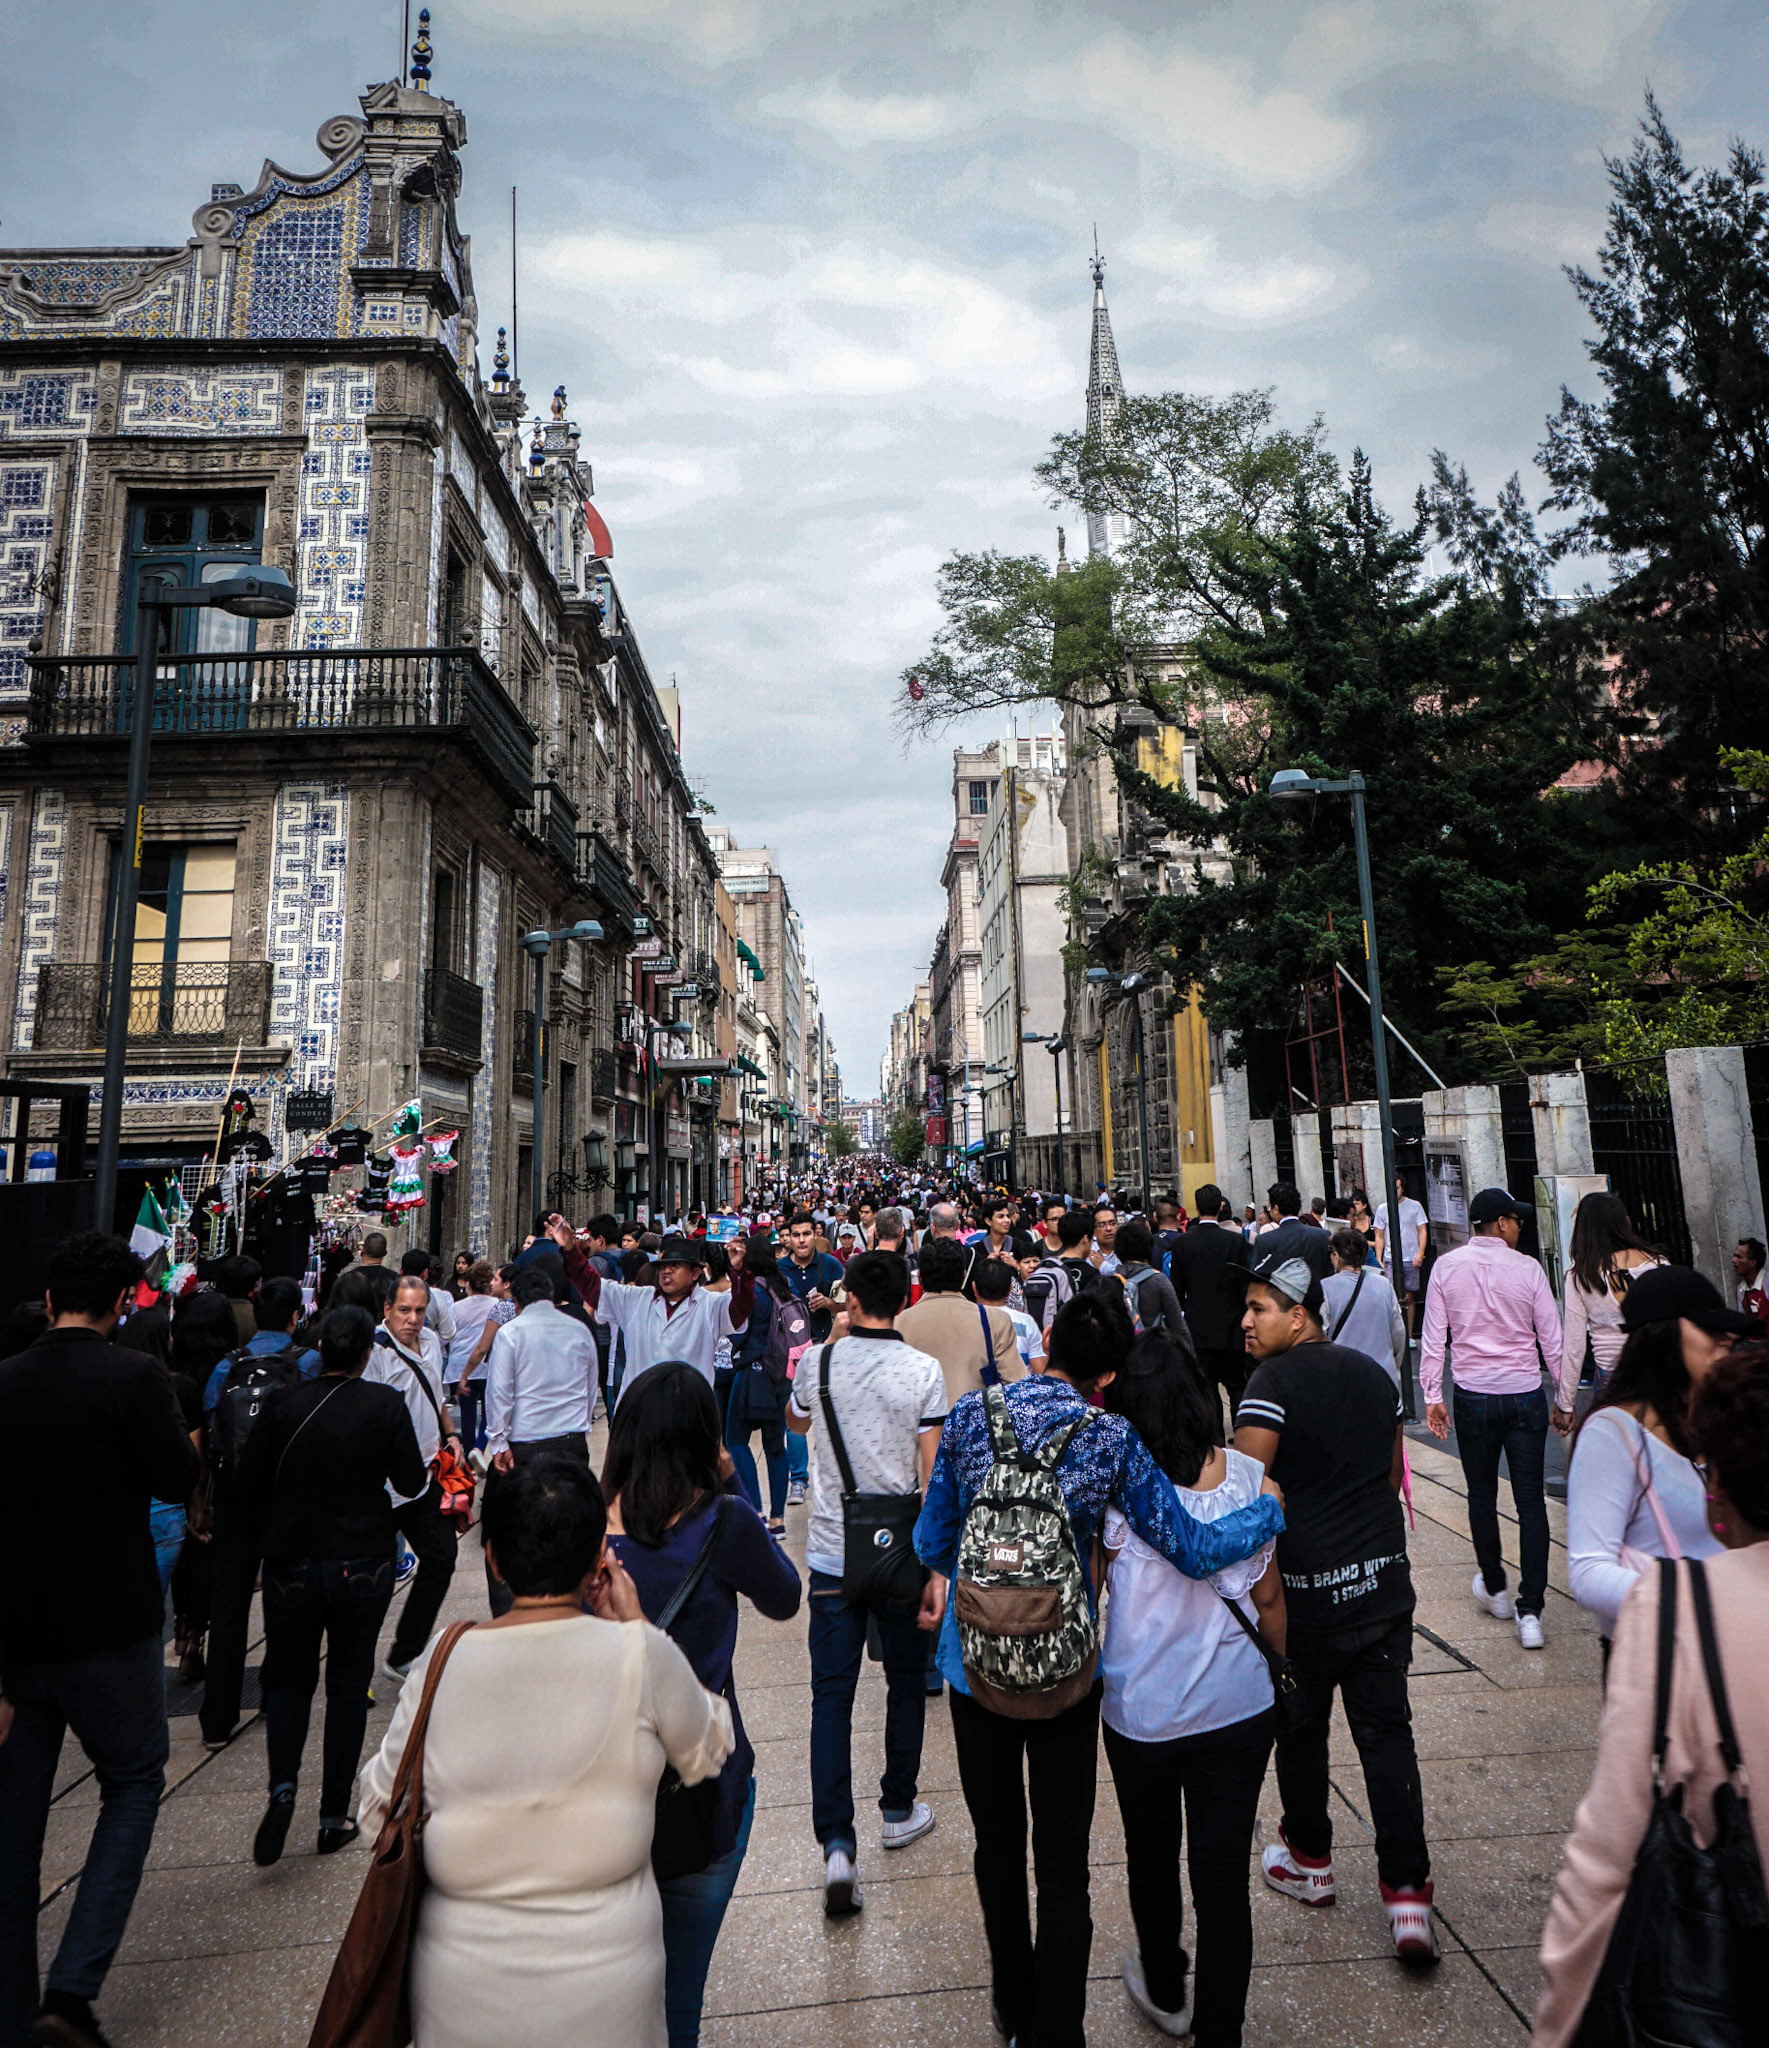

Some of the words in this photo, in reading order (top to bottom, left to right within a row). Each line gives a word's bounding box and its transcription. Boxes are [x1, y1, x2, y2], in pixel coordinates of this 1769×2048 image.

[994, 1548, 1018, 1562] VANS
[1282, 1573, 1308, 1588] THE
[1313, 1563, 1359, 1588] BRAND
[1332, 1590, 1340, 1604] 3
